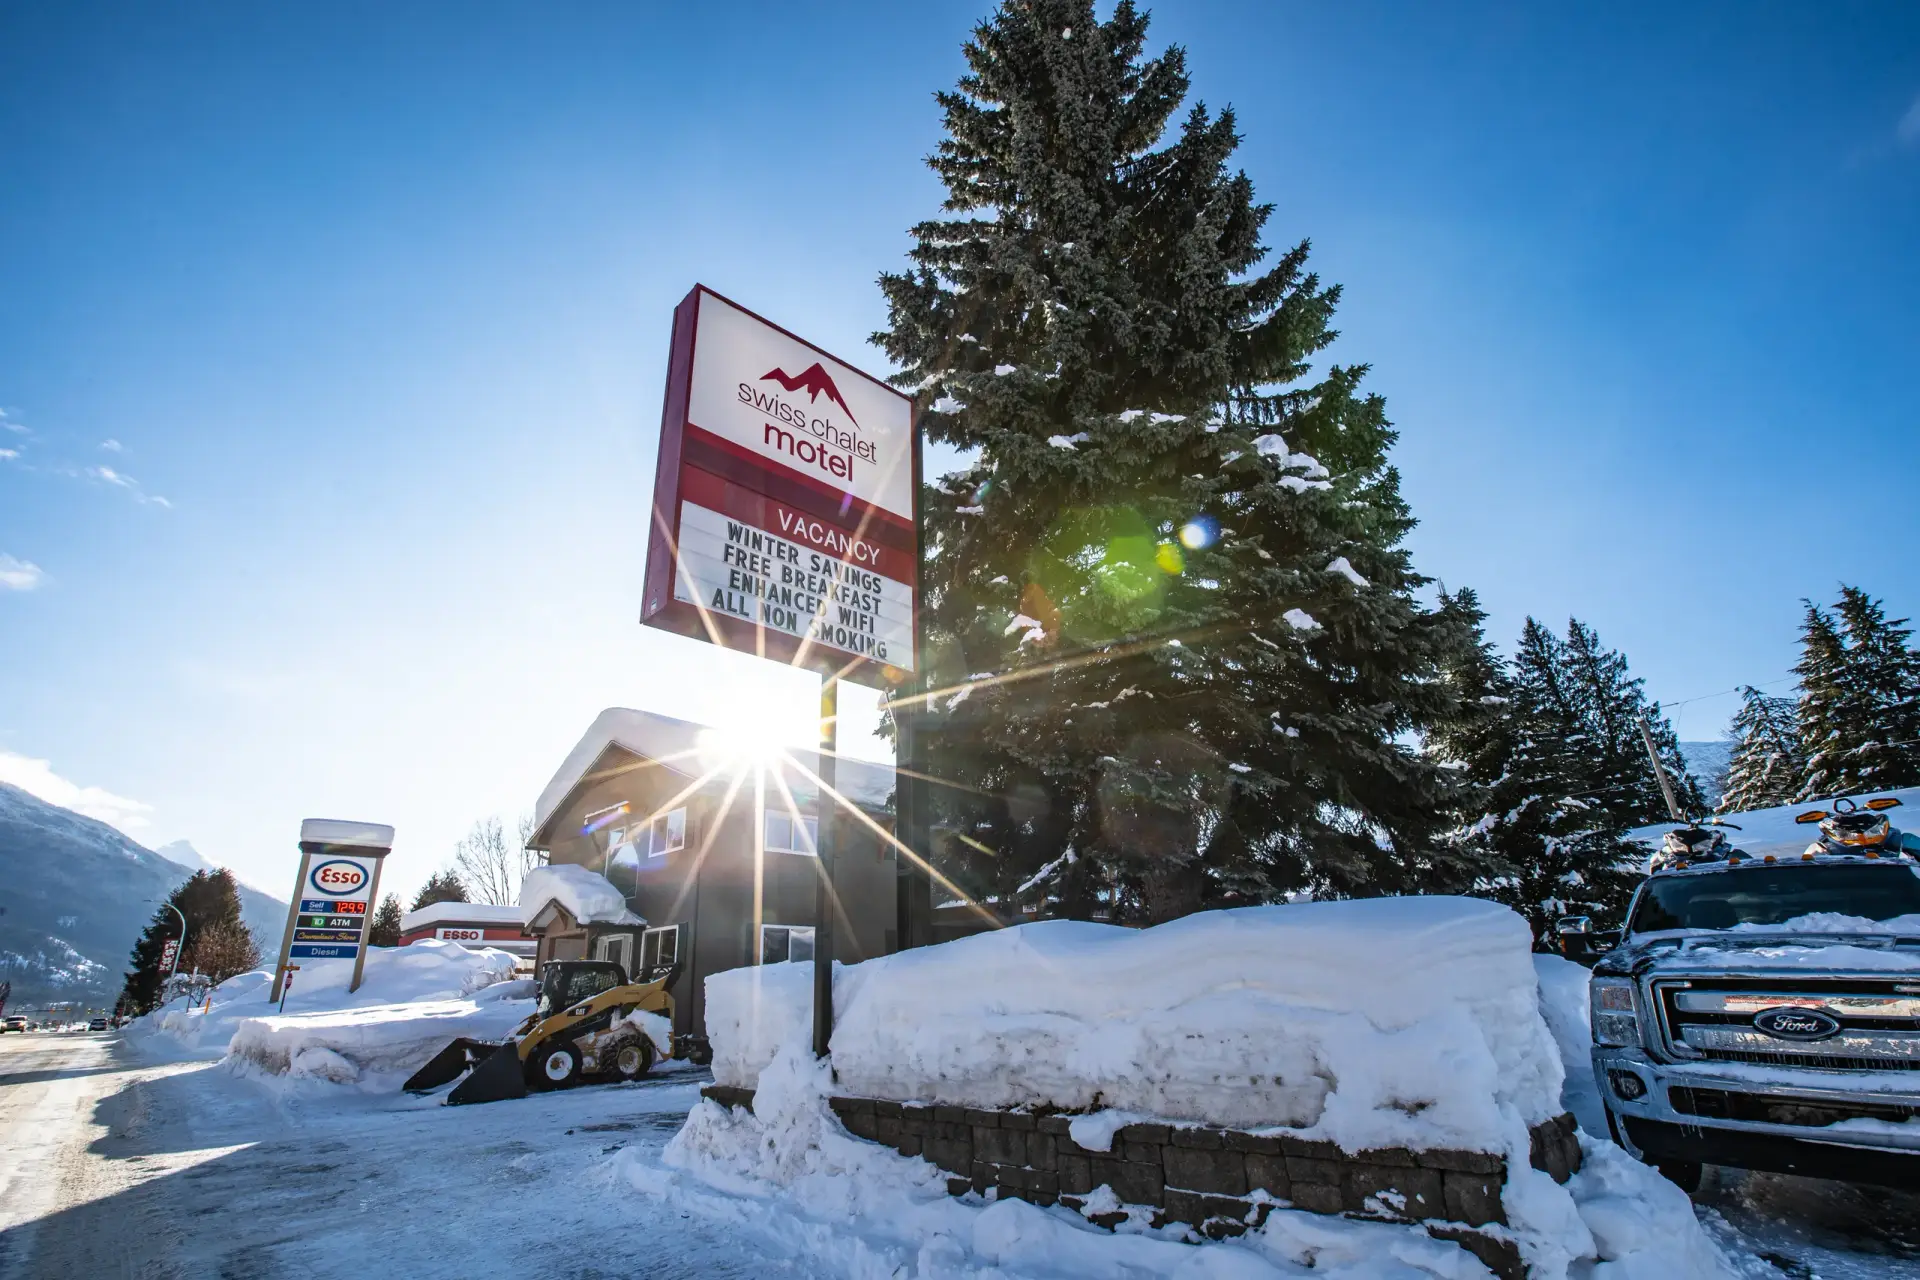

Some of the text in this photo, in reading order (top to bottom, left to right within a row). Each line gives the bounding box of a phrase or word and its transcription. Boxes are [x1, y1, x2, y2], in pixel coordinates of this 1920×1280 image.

[738, 383, 877, 462] swiss chalet
[764, 423, 853, 482] motel
[727, 521, 882, 594] WINTER SAVINGS
[778, 509, 880, 565] VACANCY
[723, 543, 882, 615] FREE BREAKFAST
[729, 569, 874, 634] ENHANCED WIFI
[711, 588, 888, 659] ALL NON SMOKING
[313, 917, 351, 926] TD ATM
[336, 902, 365, 914] 129.9
[443, 930, 479, 940] ESSO
[311, 948, 339, 956] Diesel
[575, 1008, 586, 1016] CAT
[1773, 1015, 1818, 1031] Ford
